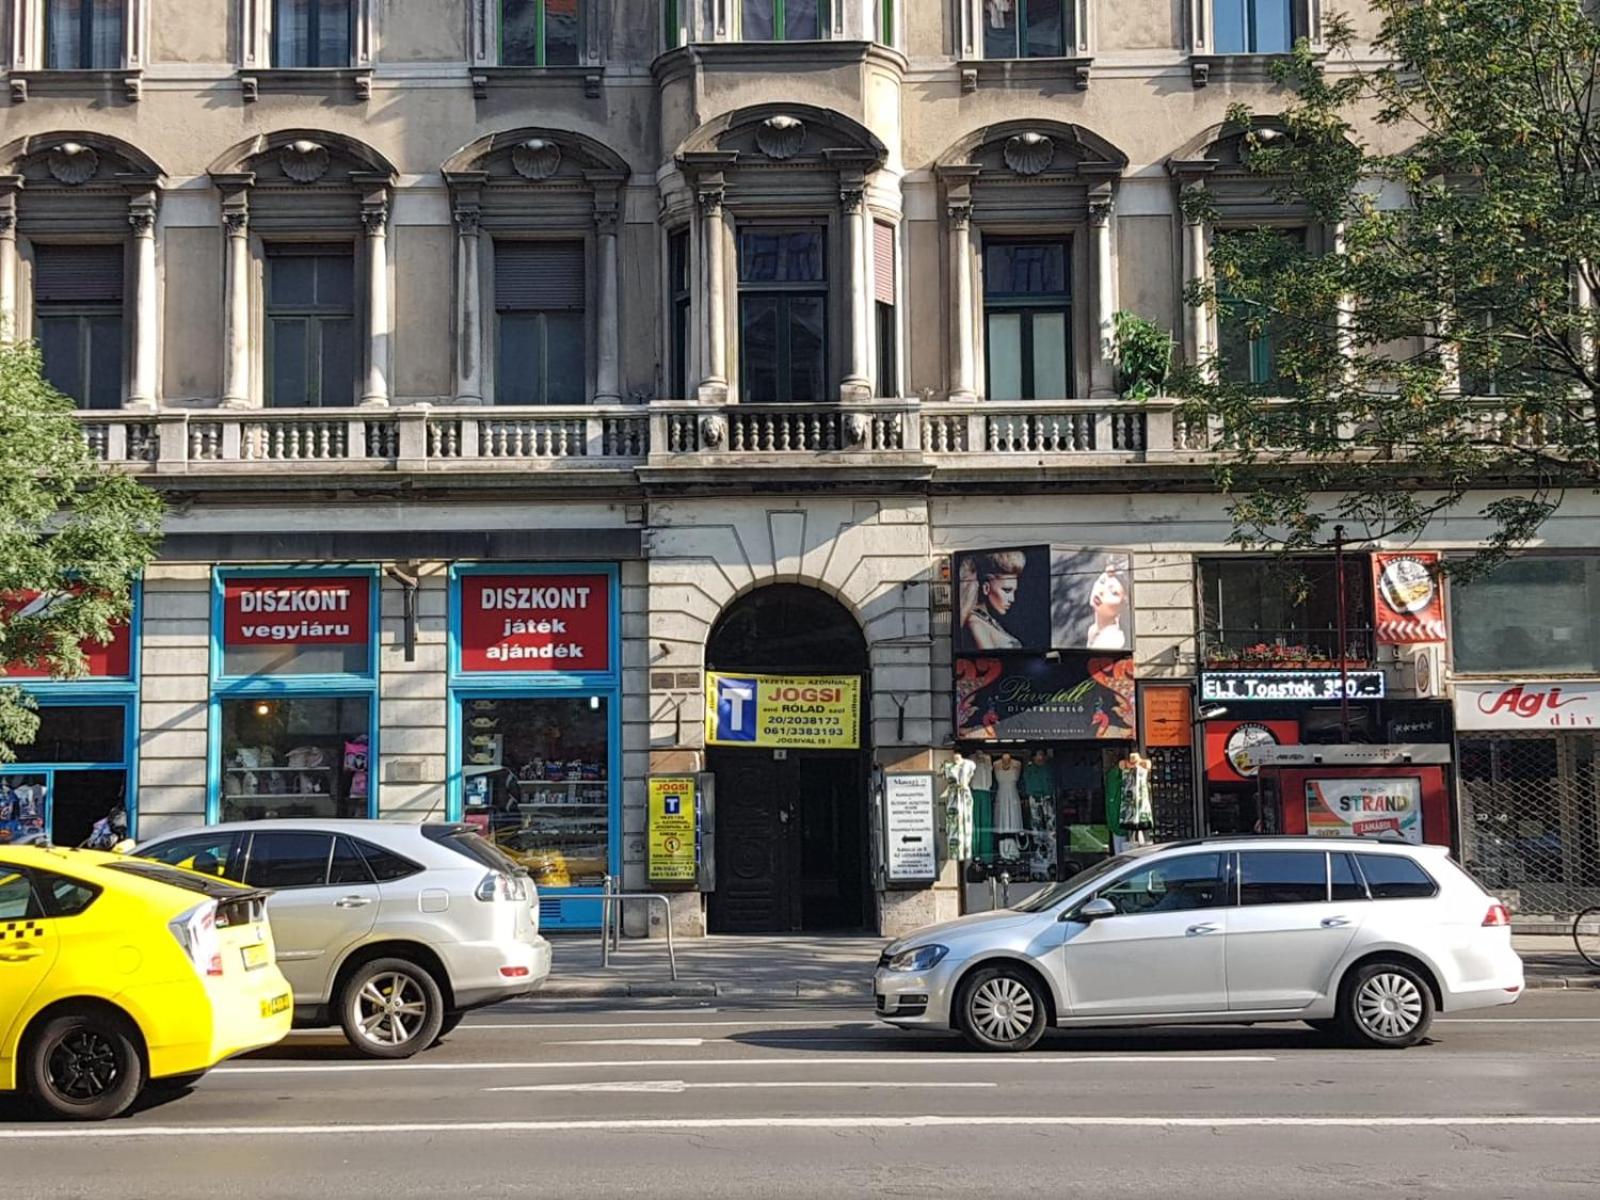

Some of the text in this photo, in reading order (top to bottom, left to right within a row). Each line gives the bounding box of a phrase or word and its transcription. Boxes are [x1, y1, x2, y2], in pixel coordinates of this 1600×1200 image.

[240, 590, 350, 612] DISZKONT
[481, 587, 590, 609] DISZKONT
[241, 621, 349, 639] vegyiáru
[503, 619, 566, 636] játék
[486, 643, 584, 661] ajándék
[768, 687, 841, 702] JOGSI
[722, 688, 752, 731] T
[782, 702, 825, 713] RÓLAD
[768, 716, 839, 725] 20/2038173
[764, 727, 843, 736] 061/3383193
[656, 783, 689, 792] JOGSI
[1340, 795, 1409, 812] STRAND
